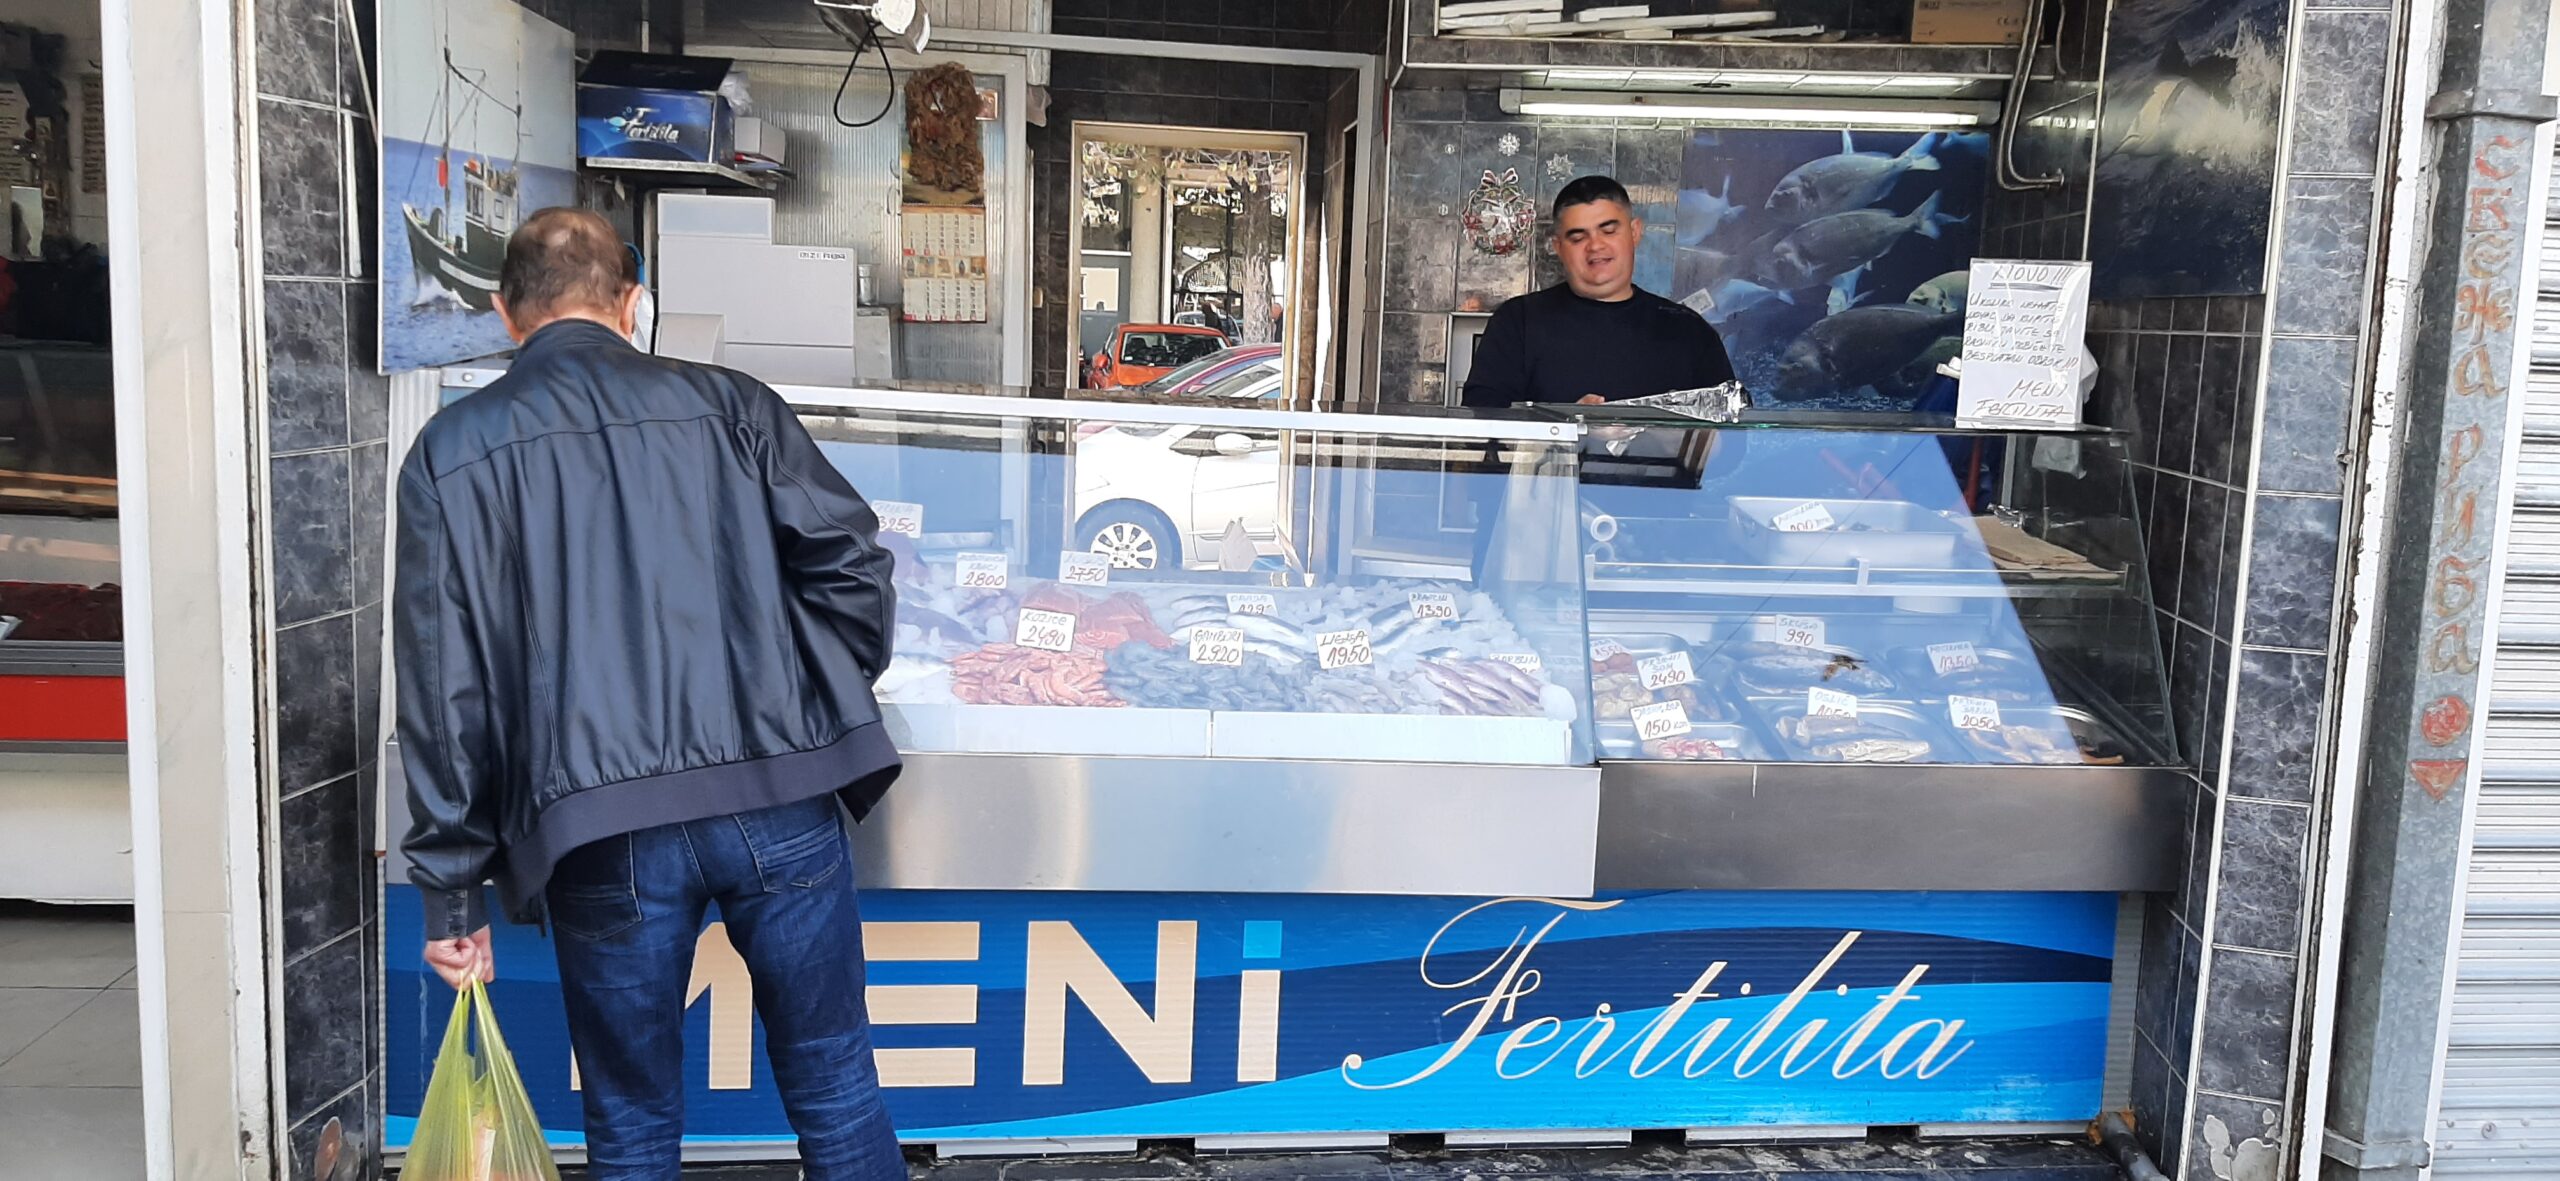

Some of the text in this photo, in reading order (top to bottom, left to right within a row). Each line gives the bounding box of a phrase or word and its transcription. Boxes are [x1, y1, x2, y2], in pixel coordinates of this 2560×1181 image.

[963, 571, 1004, 587] 2800
[1065, 565, 1106, 582] 2750
[1417, 603, 1452, 618] 1390
[1021, 624, 1066, 647] 2490
[1785, 628, 1815, 647] 990
[1196, 644, 1240, 663] 2920
[1327, 644, 1369, 667] 1950
[1650, 670, 1686, 688] 2490
[1645, 719, 1671, 738] 150
[1961, 714, 1997, 730] 2050
[1342, 896, 1973, 1090] Fertilita
